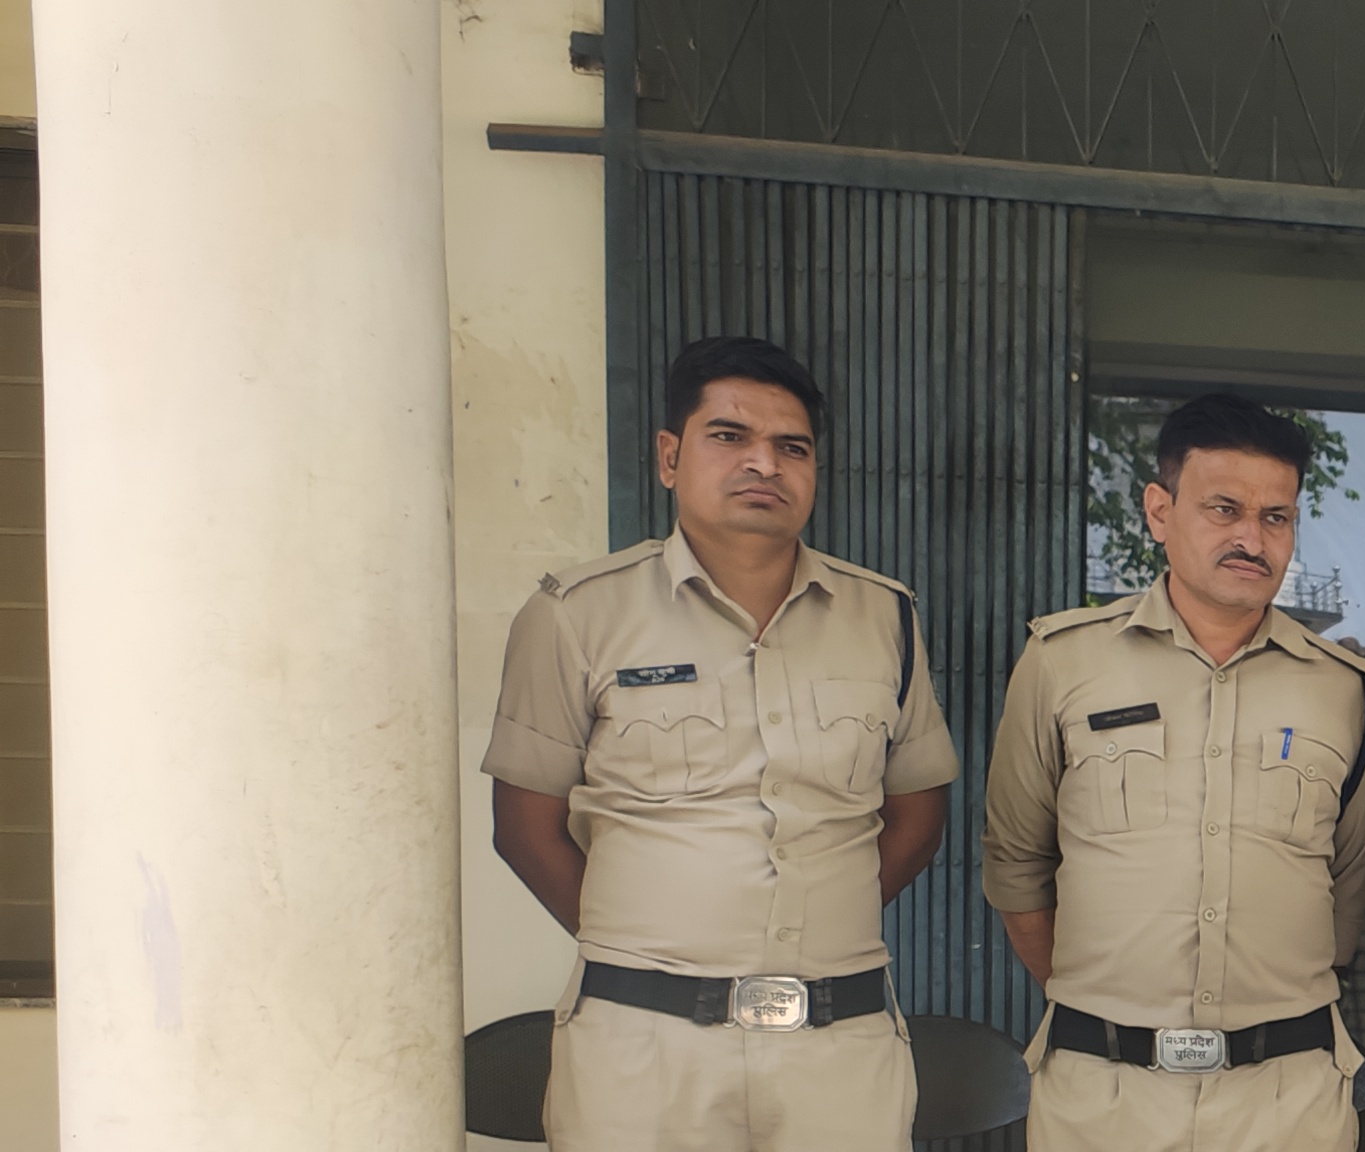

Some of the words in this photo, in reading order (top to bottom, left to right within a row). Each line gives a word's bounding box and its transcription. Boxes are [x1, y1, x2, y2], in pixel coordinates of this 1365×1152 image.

[751, 1003, 789, 1018] पुलिस
[1165, 1036, 1186, 1045] मध्य
[1189, 1034, 1215, 1047] प्रदेश
[1174, 1047, 1207, 1061] पुलिस
